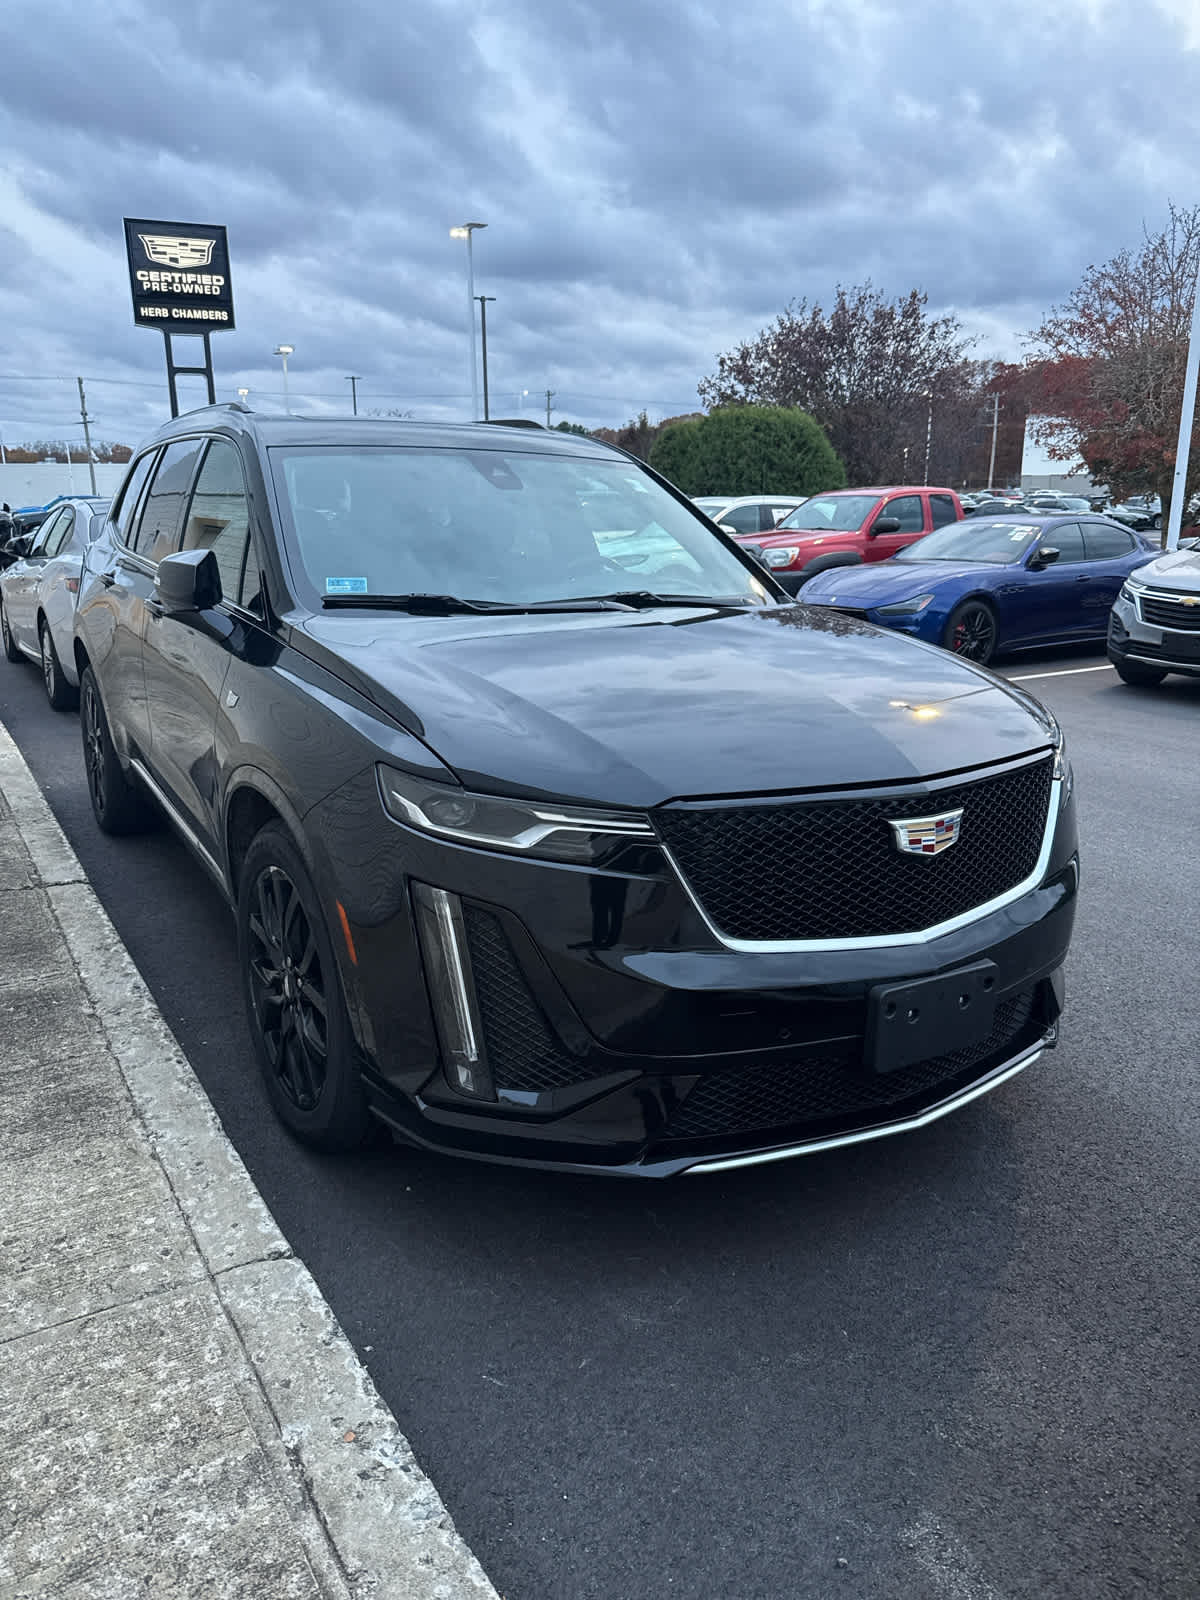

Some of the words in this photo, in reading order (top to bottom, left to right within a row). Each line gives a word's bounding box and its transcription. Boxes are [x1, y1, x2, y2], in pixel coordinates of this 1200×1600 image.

[136, 270, 225, 286] CERTIFIED
[142, 281, 221, 295] PRE-OWNED
[140, 306, 169, 318] HERB
[172, 308, 229, 321] CHAMBERS
